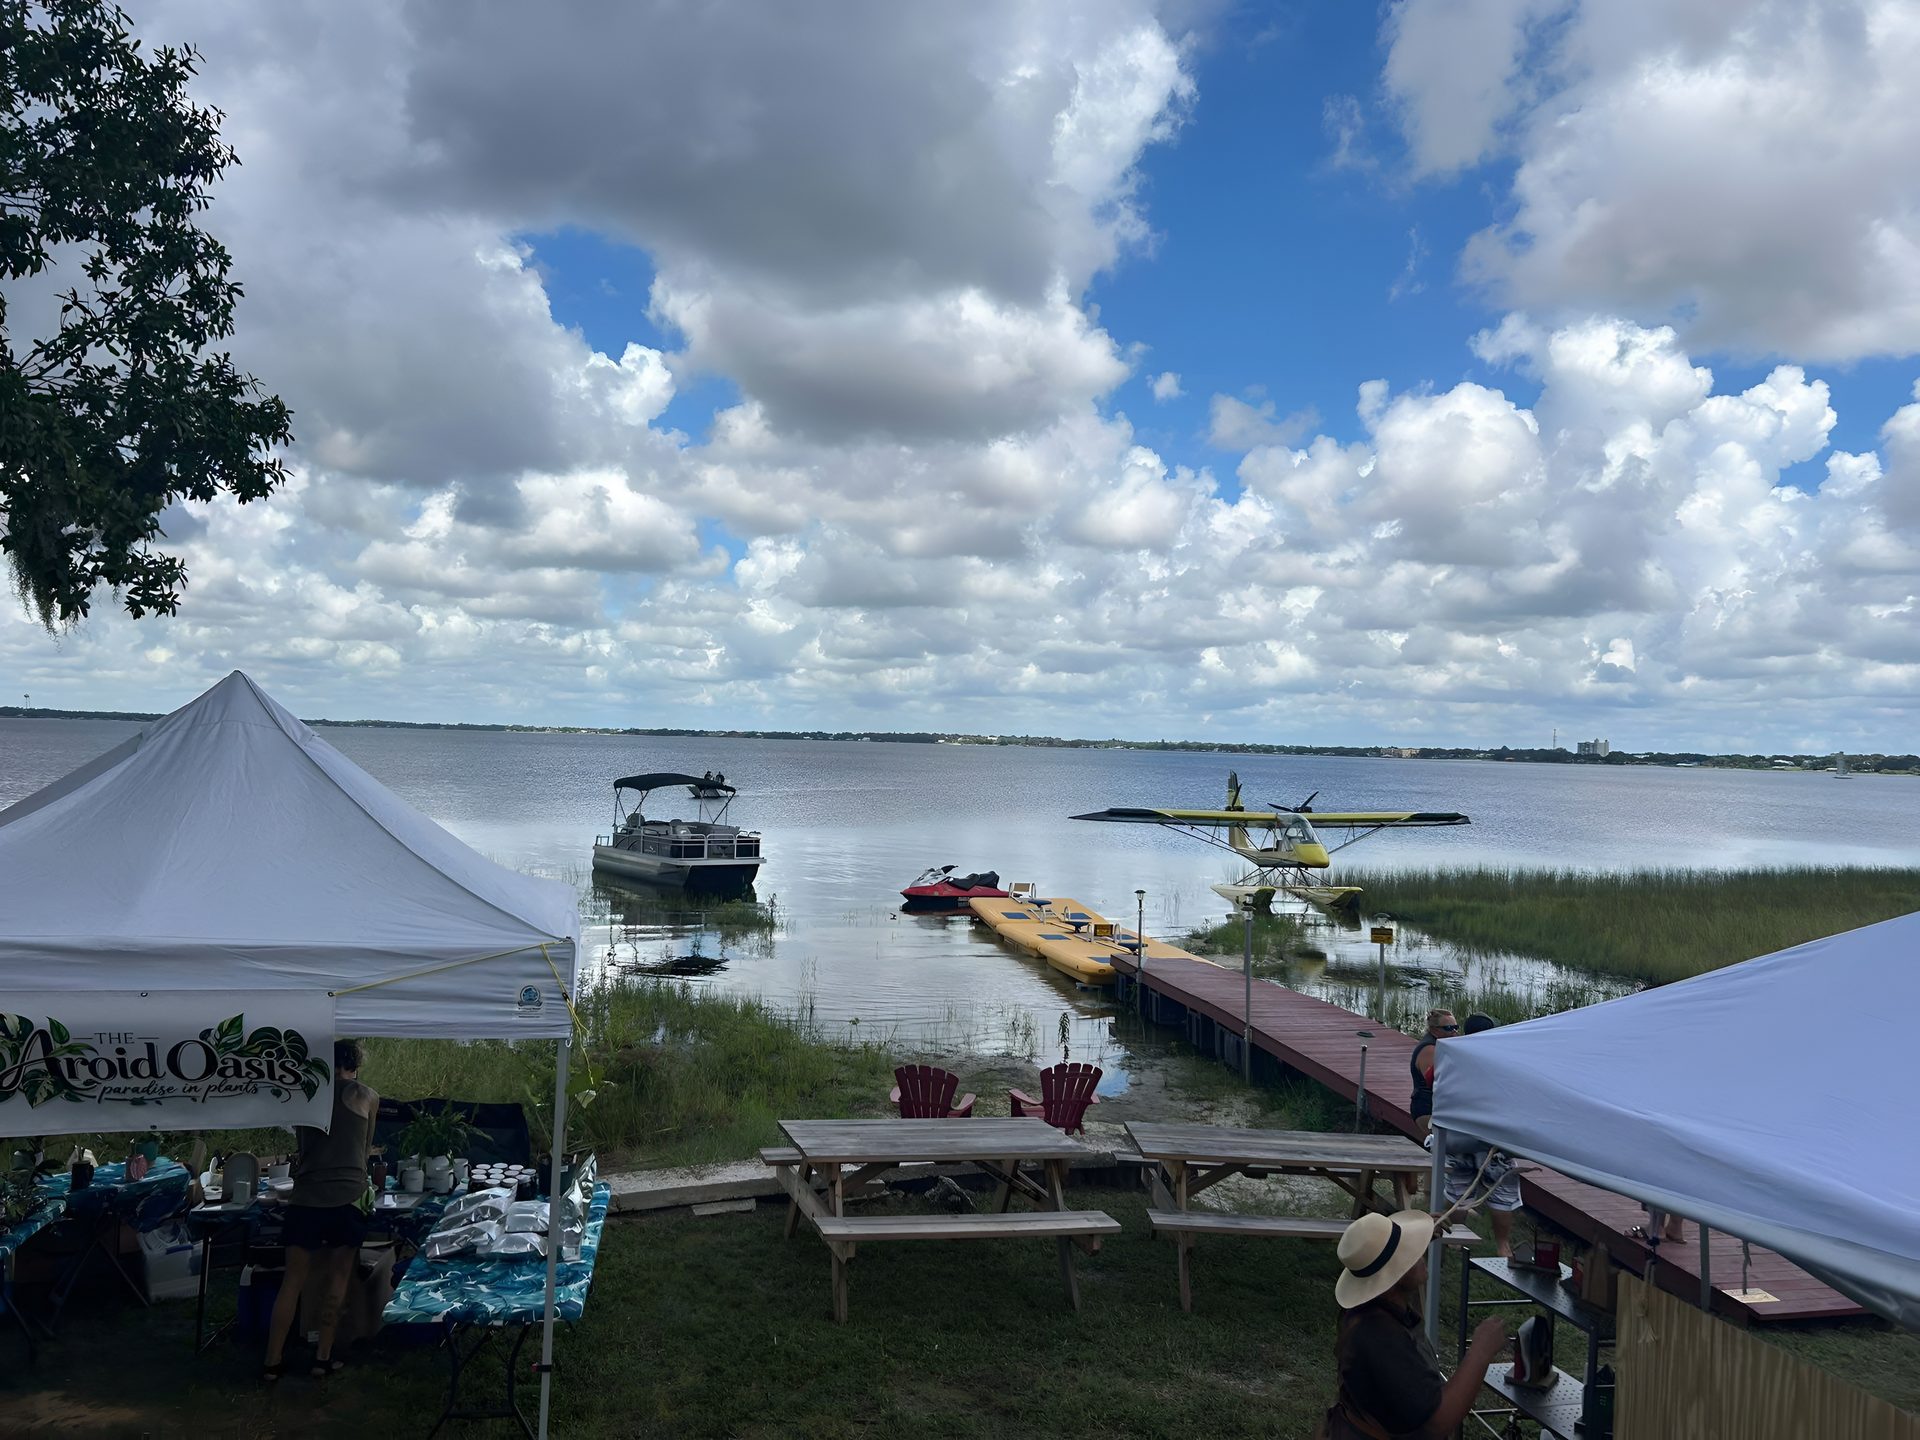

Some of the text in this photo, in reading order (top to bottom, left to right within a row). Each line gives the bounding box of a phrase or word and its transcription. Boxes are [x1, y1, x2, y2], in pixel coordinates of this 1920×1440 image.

[94, 1032, 135, 1044] THE
[0, 1028, 302, 1091] Aroid Oasis
[97, 1079, 258, 1104] paradise in plants
